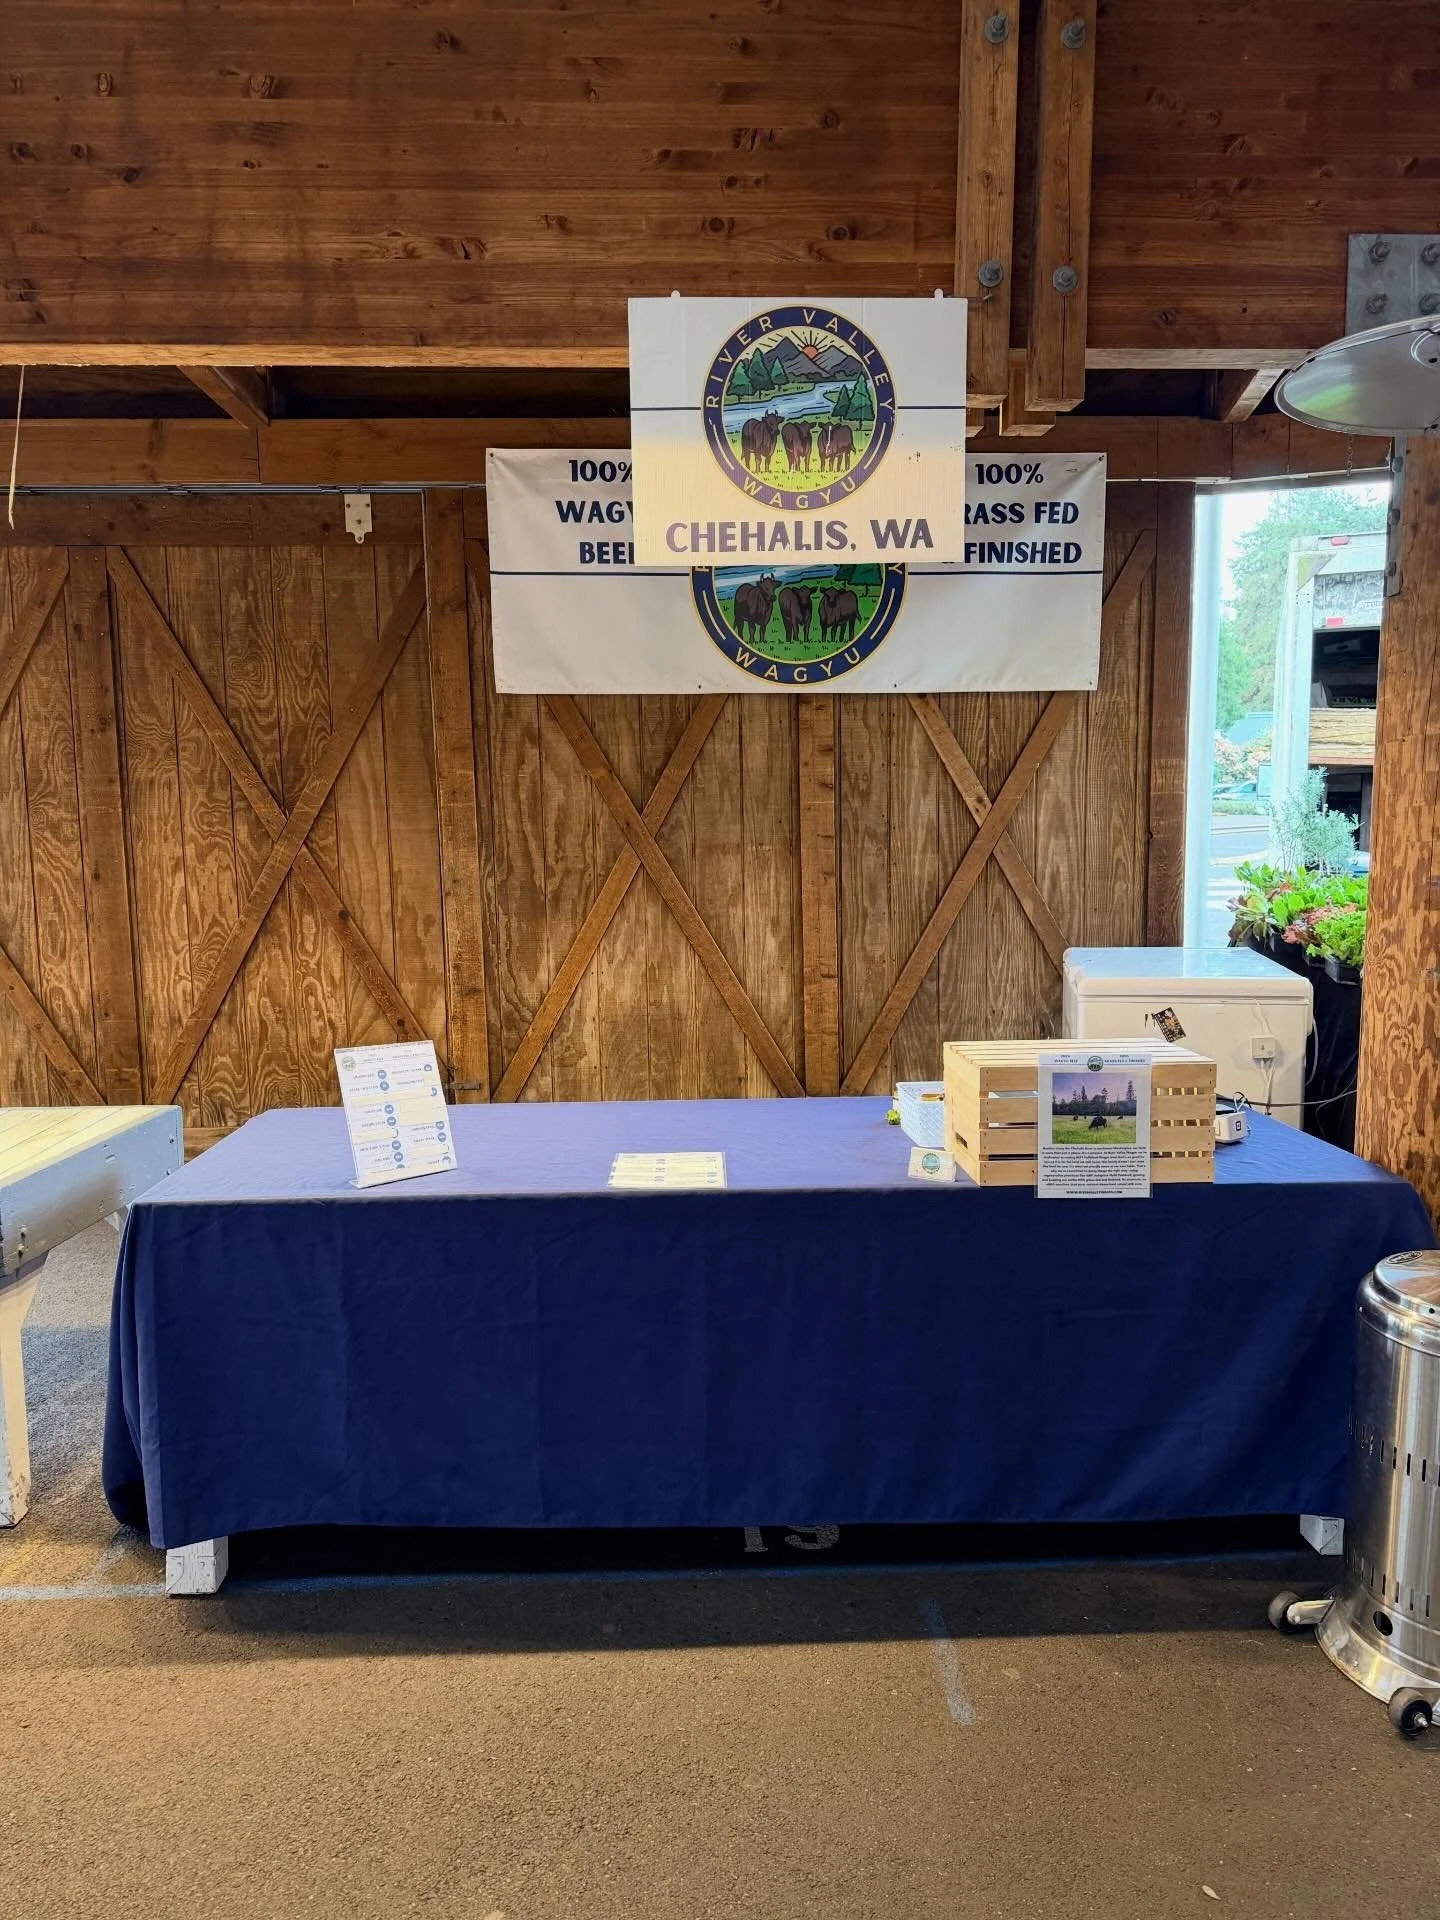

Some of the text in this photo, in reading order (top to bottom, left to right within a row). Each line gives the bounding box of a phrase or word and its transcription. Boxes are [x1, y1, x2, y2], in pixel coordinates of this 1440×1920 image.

[706, 308, 894, 411] RIVER VALLEY
[568, 459, 632, 483] 100%
[974, 462, 1044, 485] 100%
[742, 476, 857, 509] WAGYU
[1034, 501, 1080, 525] FED
[665, 518, 934, 552] CHEHALIS, WA
[964, 541, 1083, 564] FINISHED
[734, 647, 861, 683] WAGYU
